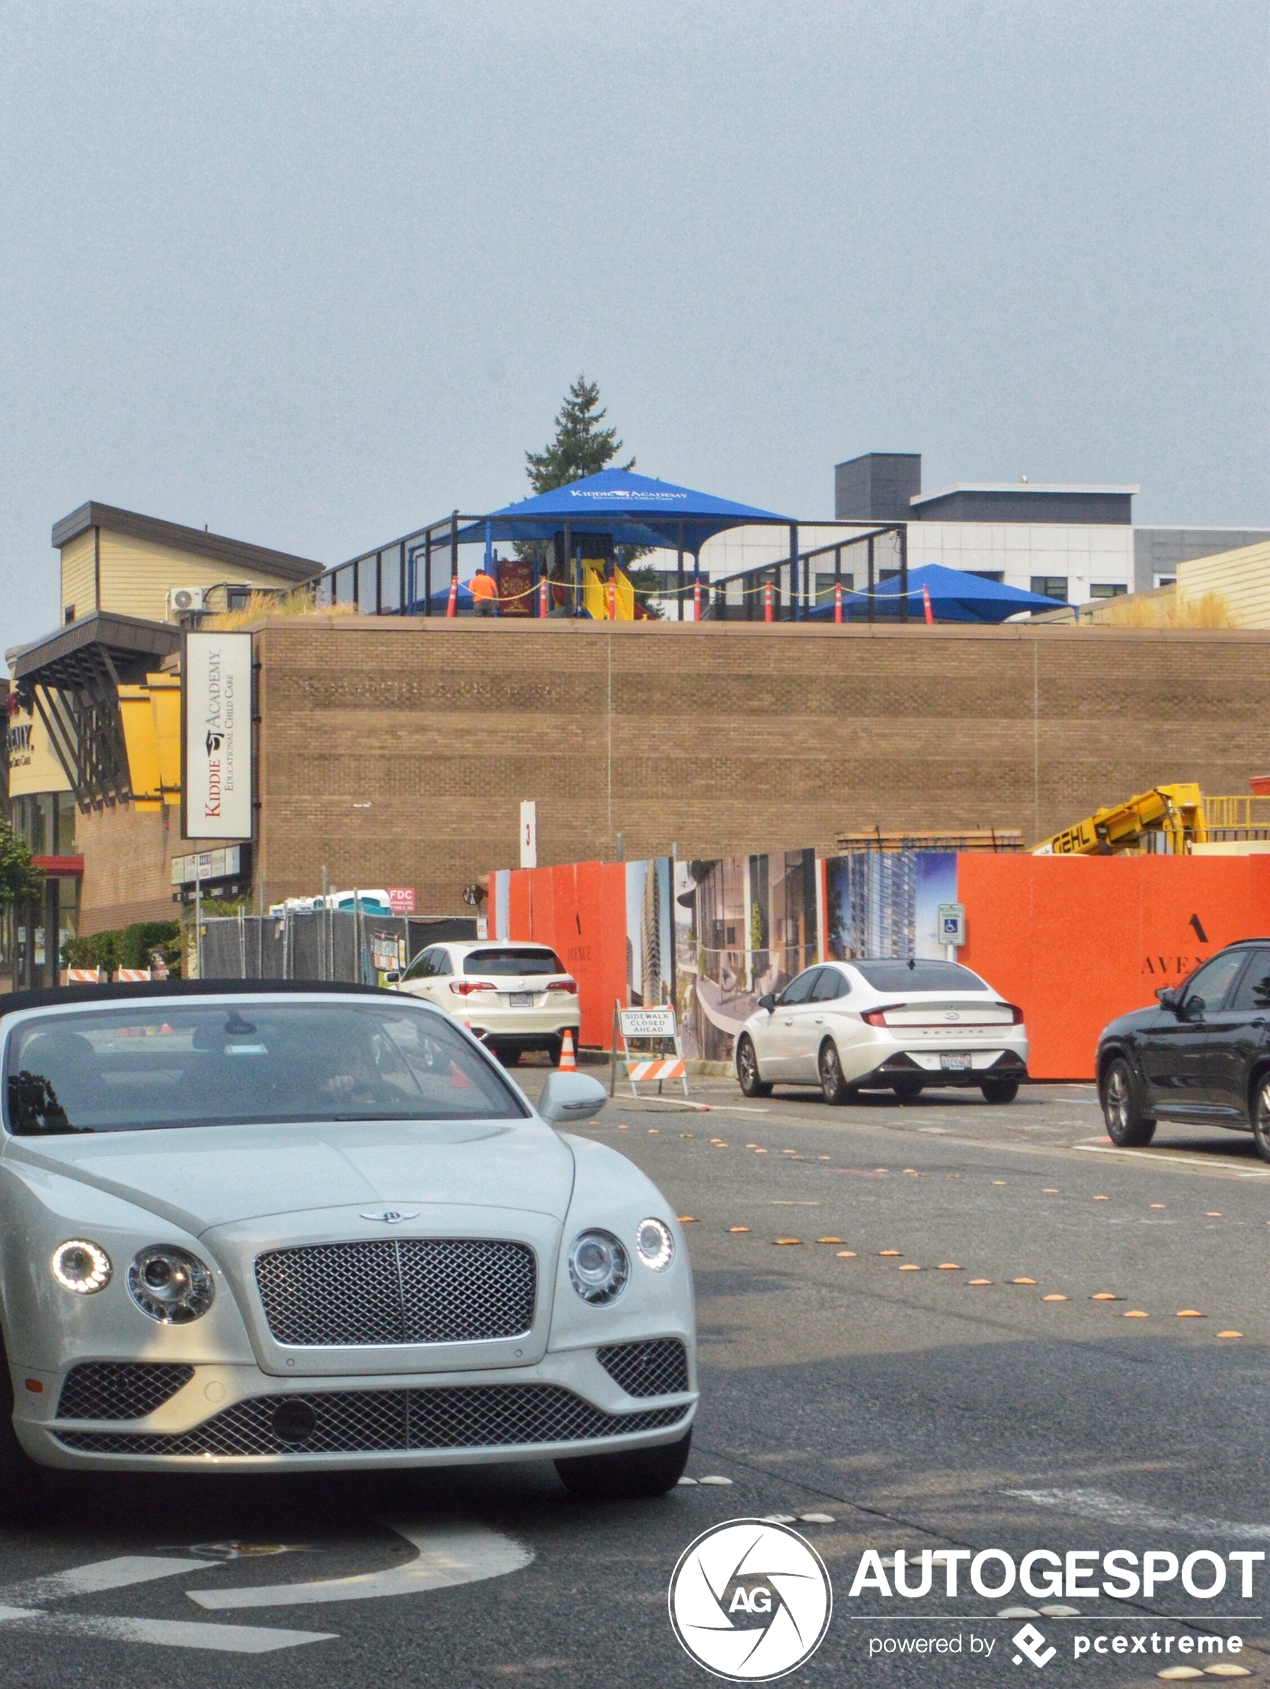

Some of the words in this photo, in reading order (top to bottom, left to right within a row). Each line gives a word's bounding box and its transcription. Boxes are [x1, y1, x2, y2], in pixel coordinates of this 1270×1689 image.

[631, 490, 687, 499] ACADEMY
[224, 674, 234, 697] CARE
[224, 700, 234, 729] CHILD
[224, 731, 234, 791] EDUCATIONAL
[205, 759, 221, 818] KIDDIE
[526, 823, 531, 846] 3
[1052, 825, 1090, 853] GEHL
[390, 890, 412, 900] FDC
